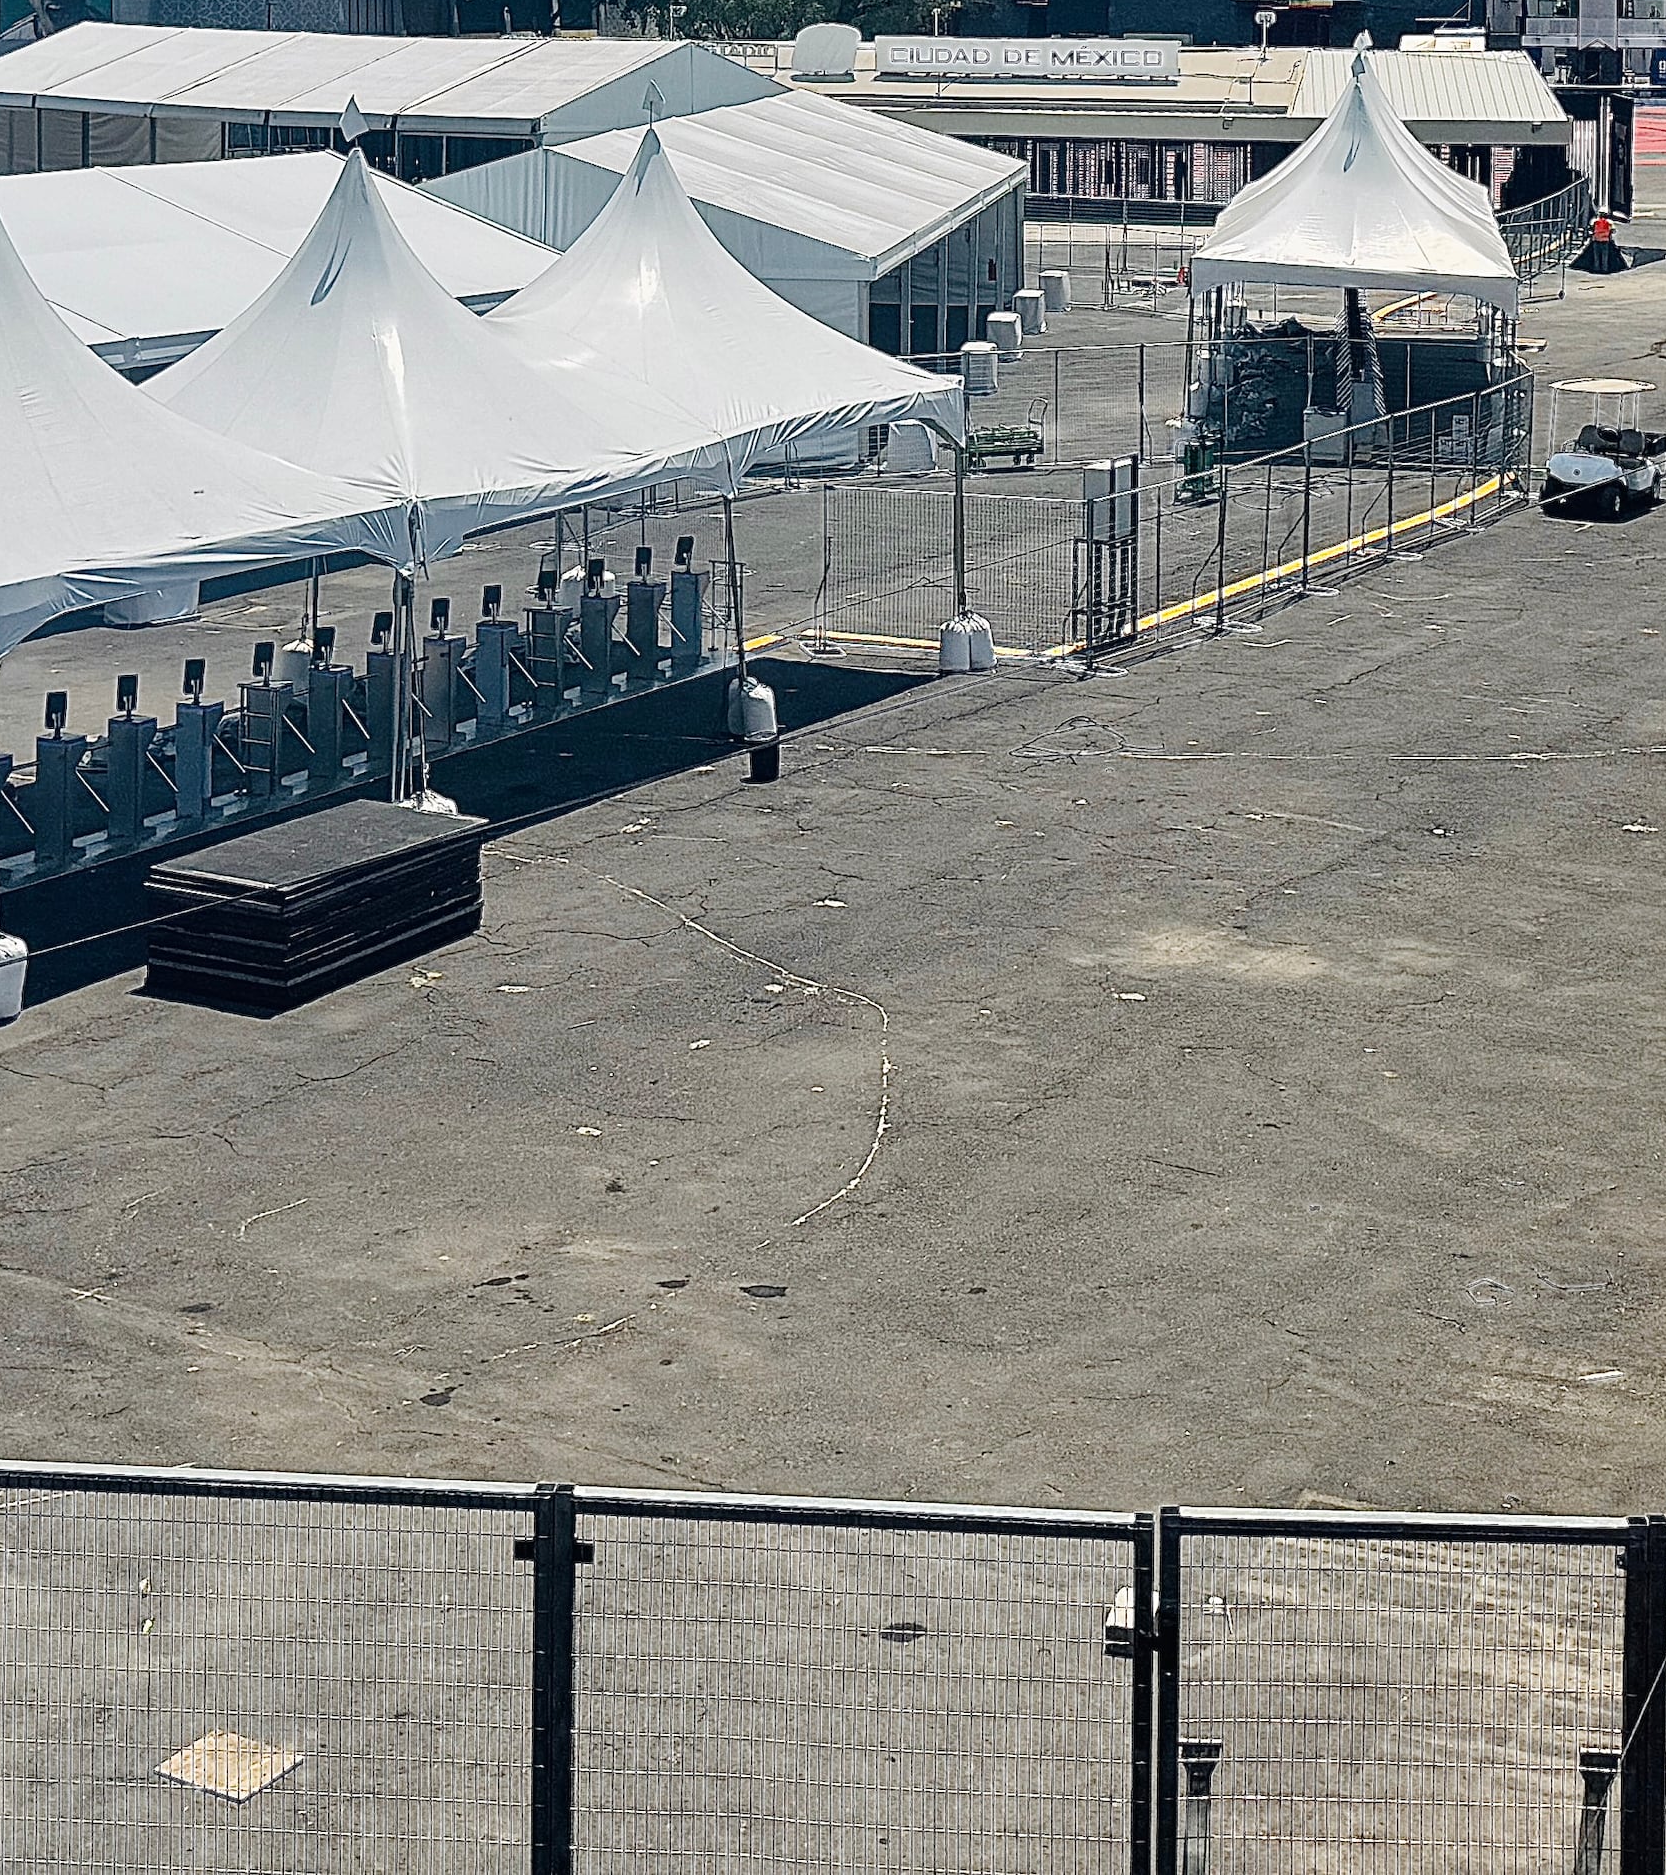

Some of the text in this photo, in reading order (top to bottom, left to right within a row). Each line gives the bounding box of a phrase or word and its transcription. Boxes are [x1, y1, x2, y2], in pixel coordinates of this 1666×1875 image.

[889, 44, 1163, 68] CIUDAD DE MÉXICO
